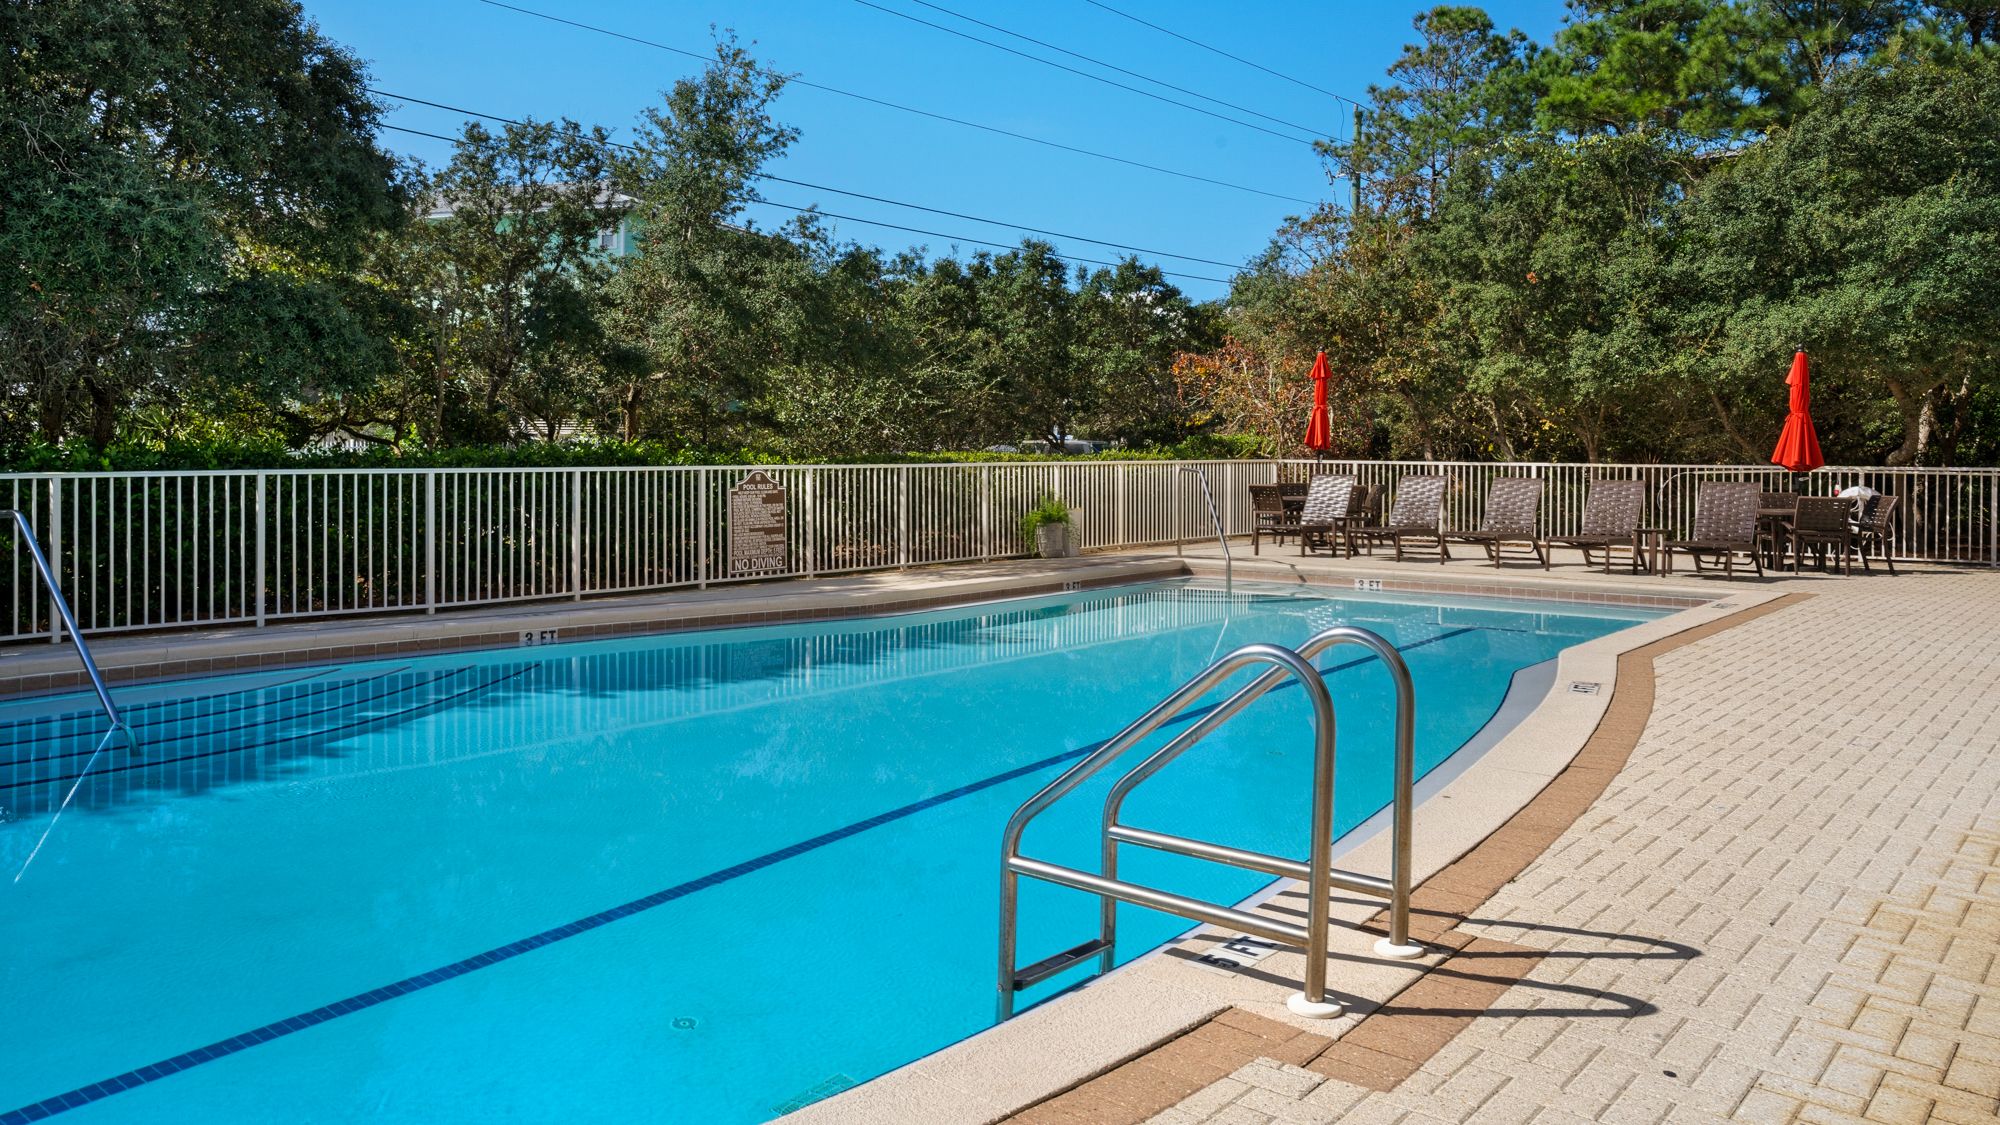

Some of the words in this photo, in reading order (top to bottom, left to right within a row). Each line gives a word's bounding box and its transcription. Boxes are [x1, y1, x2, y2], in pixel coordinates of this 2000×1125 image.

[735, 559, 749, 570] NO
[752, 556, 783, 569] DIVING
[1222, 935, 1278, 957] FT
